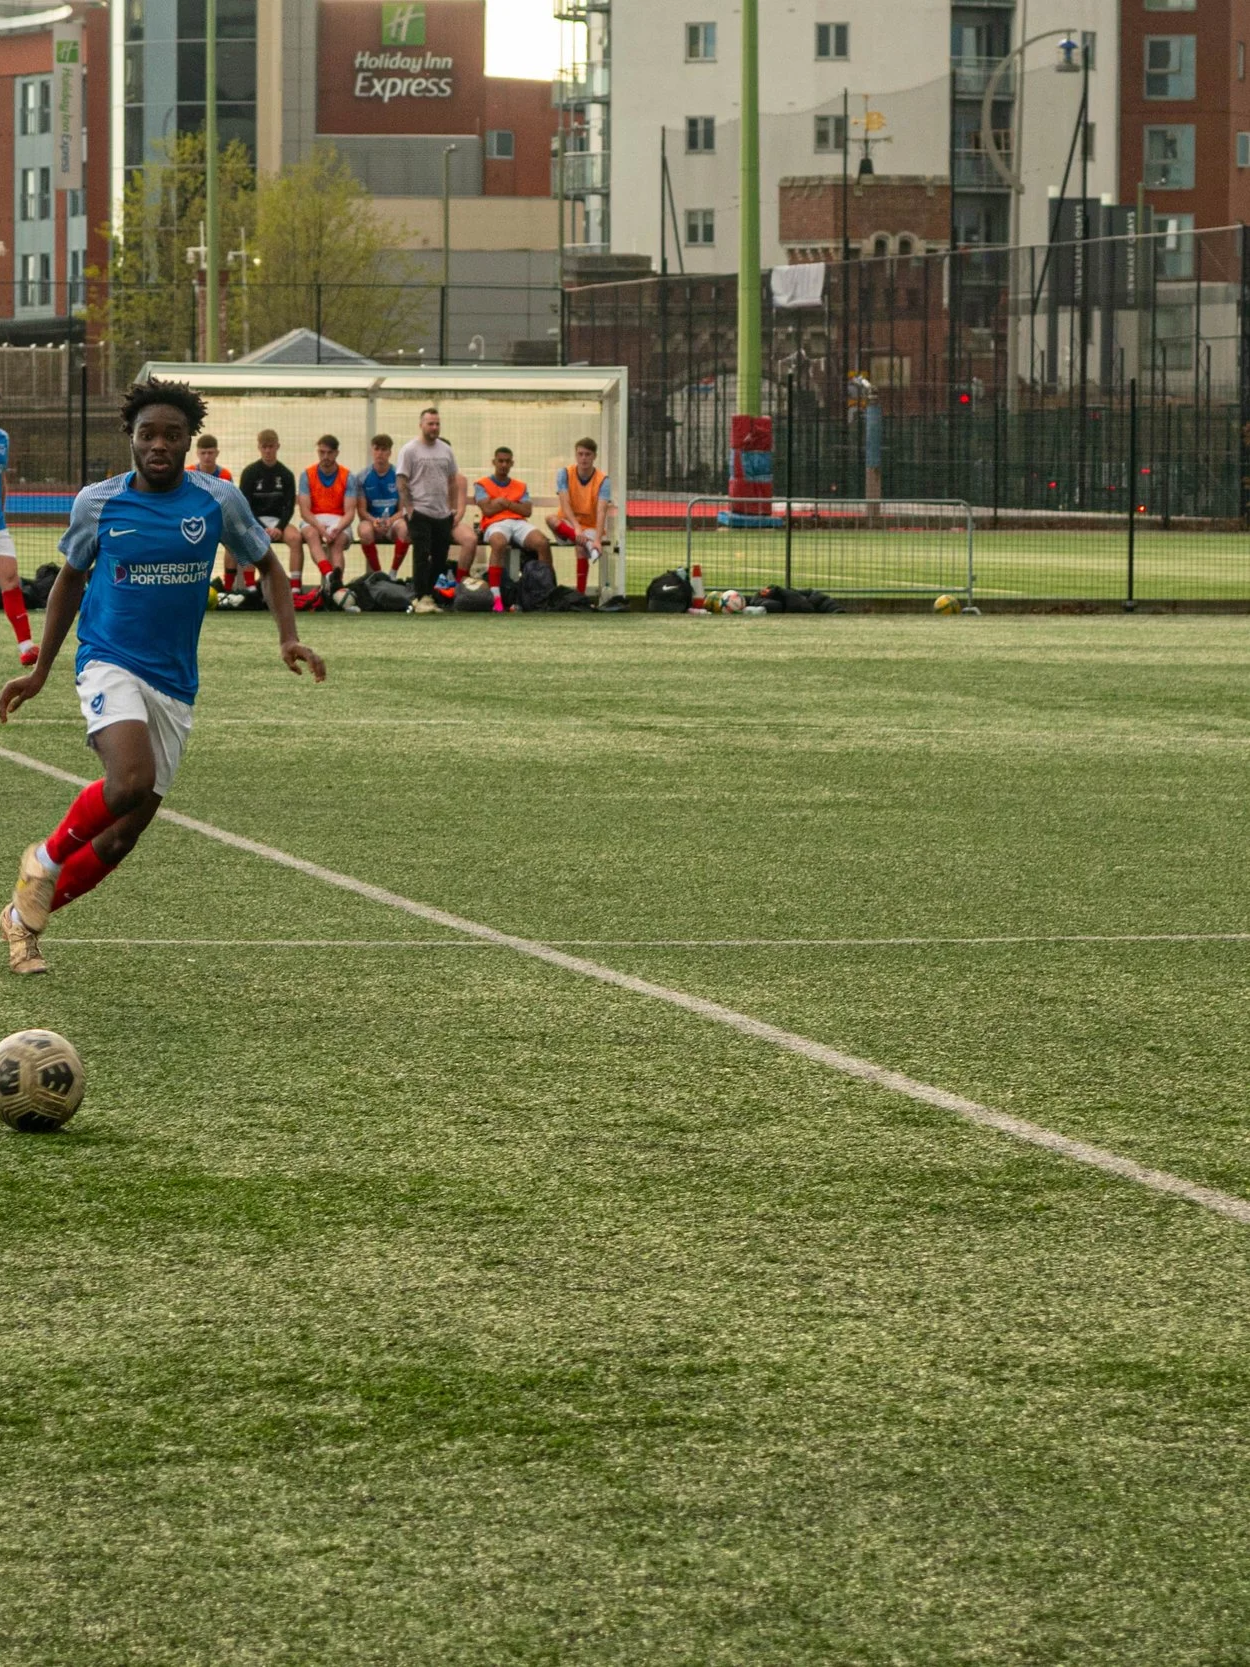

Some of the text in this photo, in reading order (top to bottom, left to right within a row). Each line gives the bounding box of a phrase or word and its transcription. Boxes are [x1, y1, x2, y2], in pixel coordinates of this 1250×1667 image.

[355, 51, 453, 73] Holiday Inn
[355, 72, 453, 103] Express
[130, 562, 202, 574] UNIVERSITY
[130, 570, 208, 585] PORTSMOUTH
